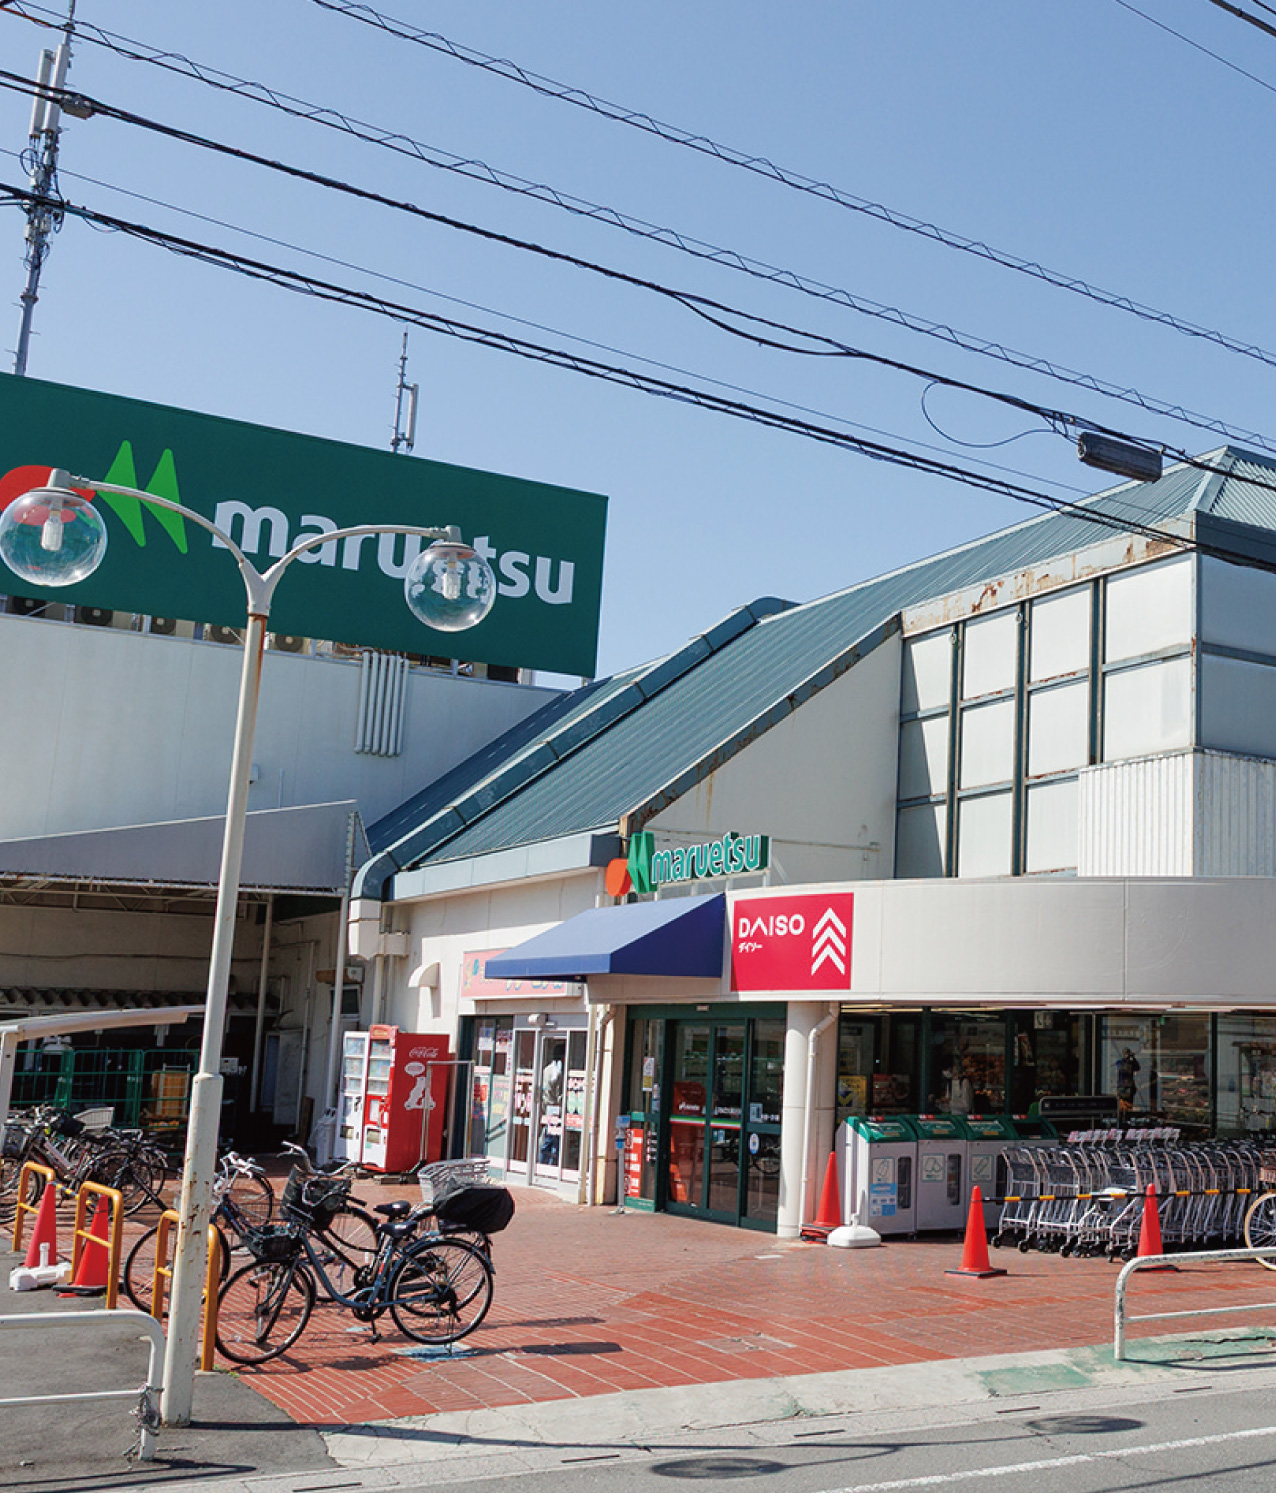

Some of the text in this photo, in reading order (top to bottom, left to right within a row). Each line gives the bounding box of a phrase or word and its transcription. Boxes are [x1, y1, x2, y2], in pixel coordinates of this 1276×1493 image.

[211, 500, 575, 605] marutsu
[651, 831, 764, 884] maruetsu
[738, 913, 806, 938] DAISO
